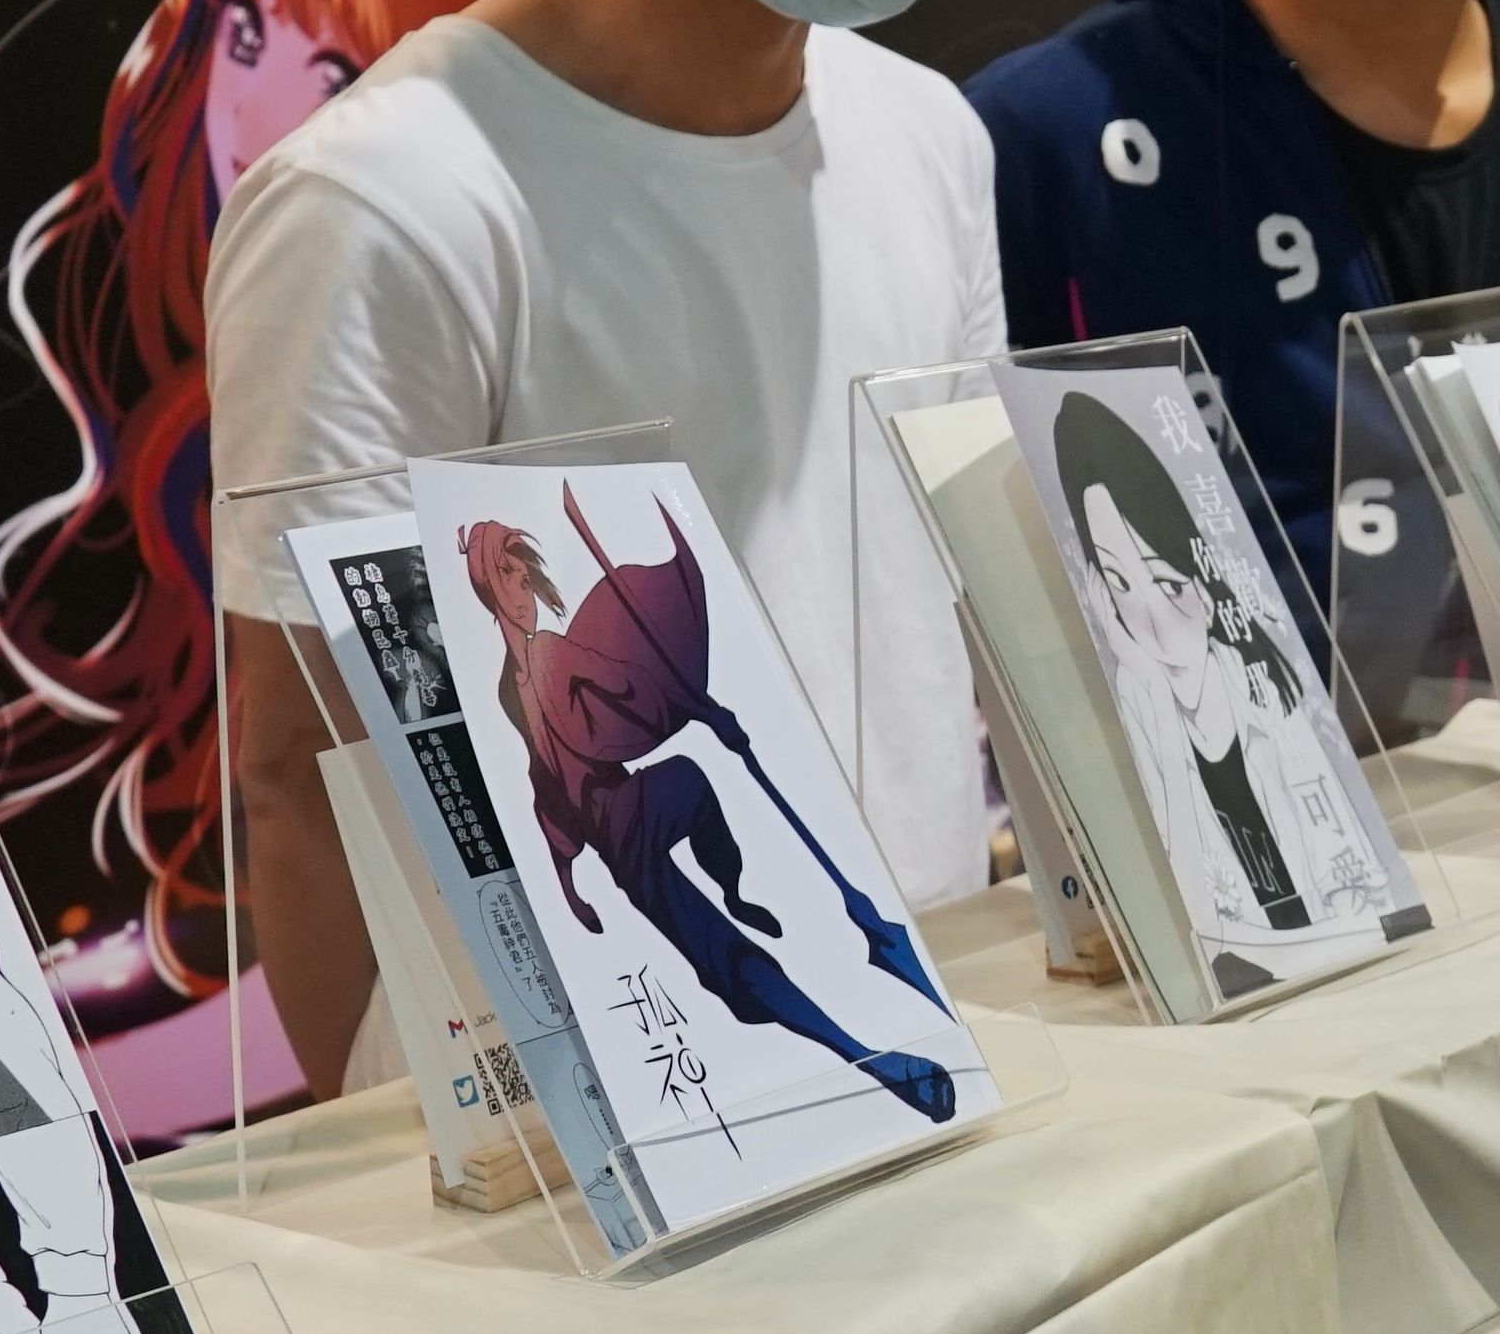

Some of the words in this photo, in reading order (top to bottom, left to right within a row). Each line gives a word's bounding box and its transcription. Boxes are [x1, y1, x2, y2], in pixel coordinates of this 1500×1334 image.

[1256, 212, 1320, 302] 9
[1339, 477, 1399, 556] 6
[1189, 536, 1388, 918] 你的那可愛
